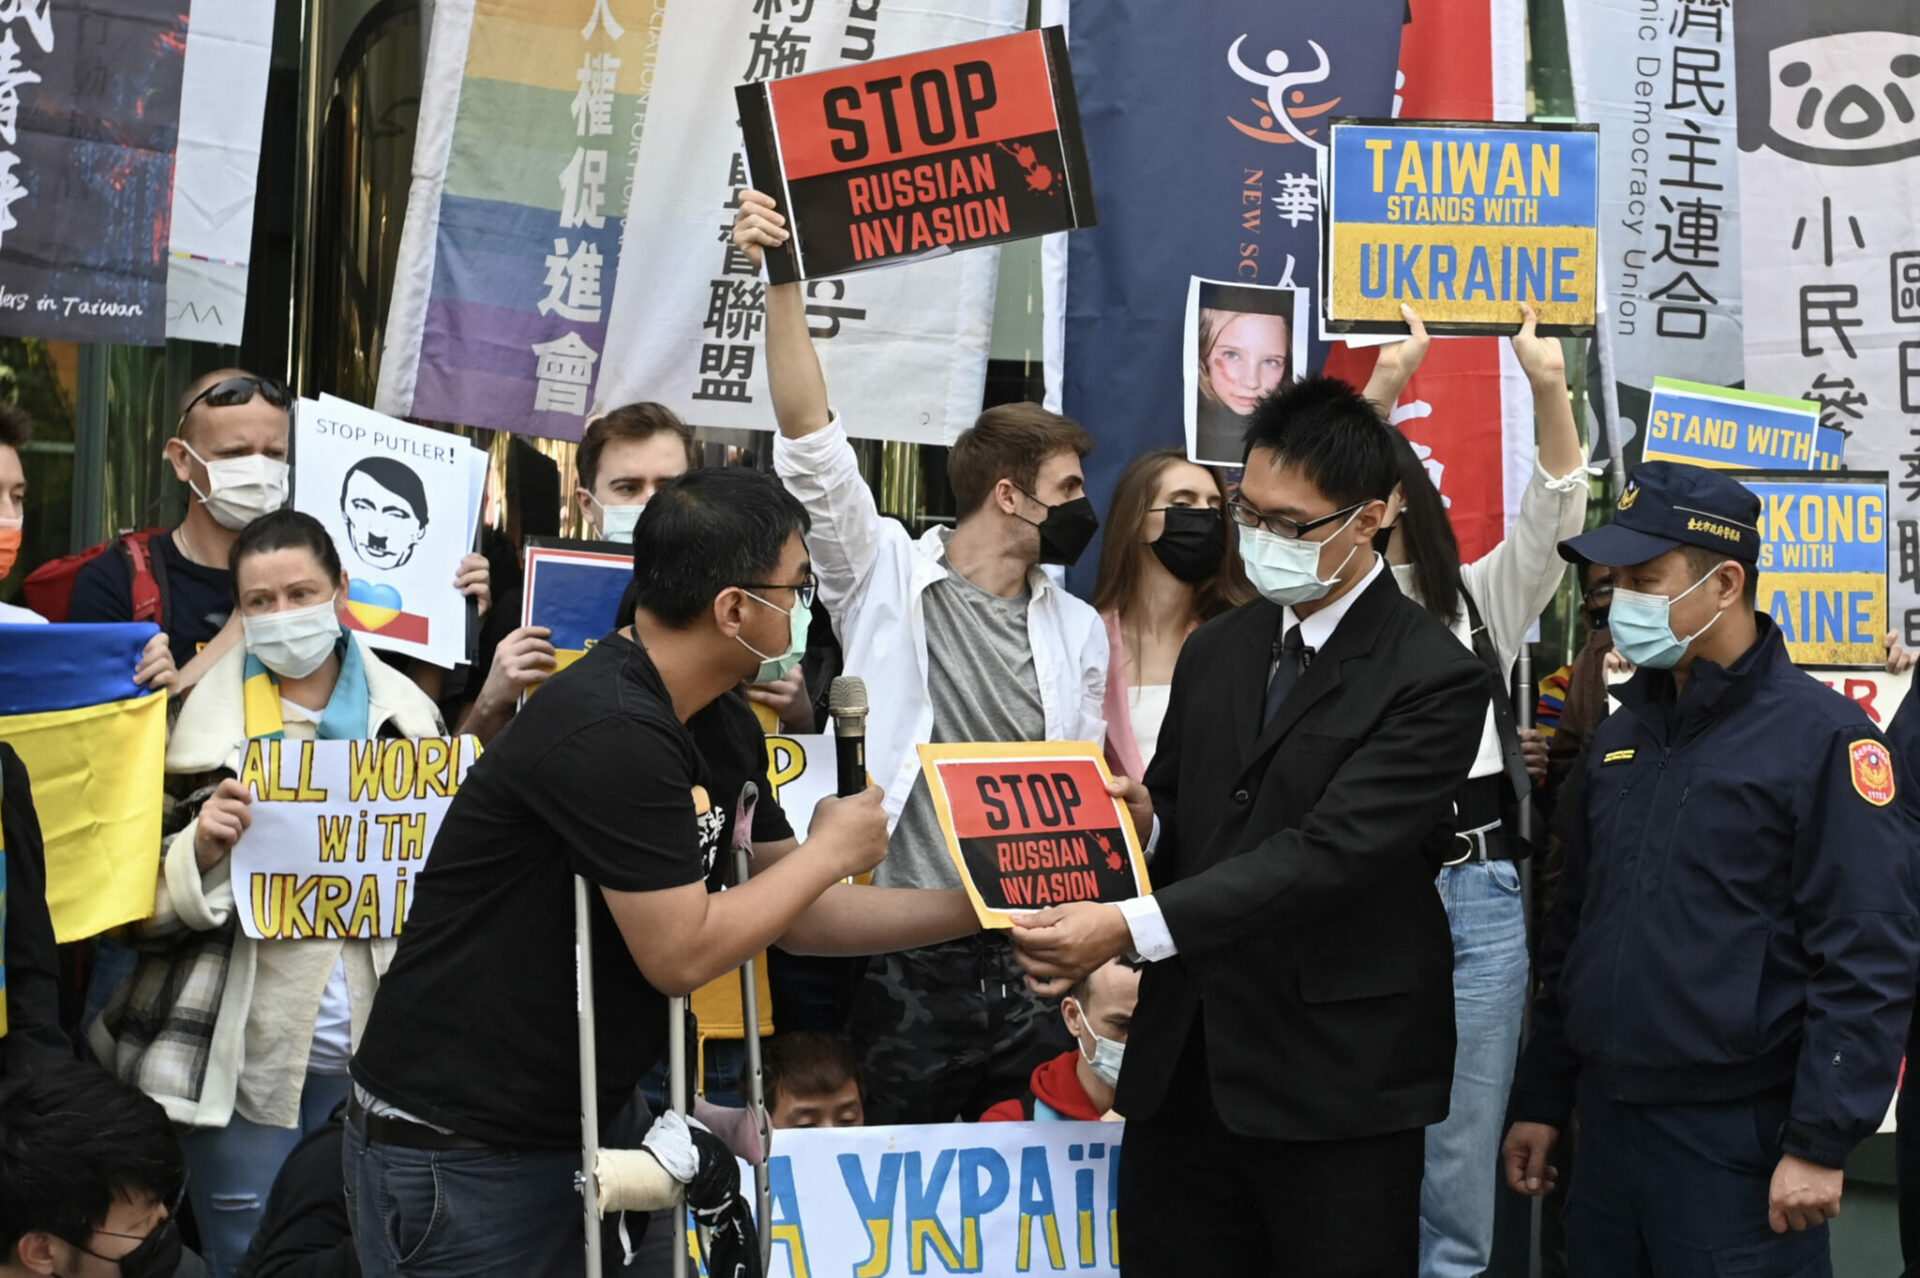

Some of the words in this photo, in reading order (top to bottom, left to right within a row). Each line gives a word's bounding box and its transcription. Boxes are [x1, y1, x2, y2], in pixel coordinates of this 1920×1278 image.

[822, 60, 997, 163] STOP
[1365, 139, 1560, 197] TAIWAN
[1621, 56, 1661, 236] Democracy
[847, 153, 996, 217] RUSSIAN
[1241, 167, 1264, 234] NEW
[1387, 195, 1475, 222] STANDS
[1483, 198, 1538, 224] WITH
[849, 196, 1011, 261] INVASION
[1238, 242, 1259, 284] SC
[1359, 242, 1579, 302] UKRAINE
[62, 296, 143, 318] Taiwan
[1617, 249, 1648, 337] Union
[316, 418, 367, 441] STOP
[373, 431, 455, 464] PUTLER!
[1652, 410, 1738, 450] STAND
[1747, 424, 1812, 461] WITH
[1782, 544, 1834, 568] WITH
[240, 738, 328, 803] ALL
[349, 735, 484, 802] WORL
[976, 772, 1082, 831] STOP
[996, 836, 1089, 873] RUSSIAN
[1000, 870, 1100, 906] INVASION
[837, 1142, 1120, 1278] УКРАЇ
